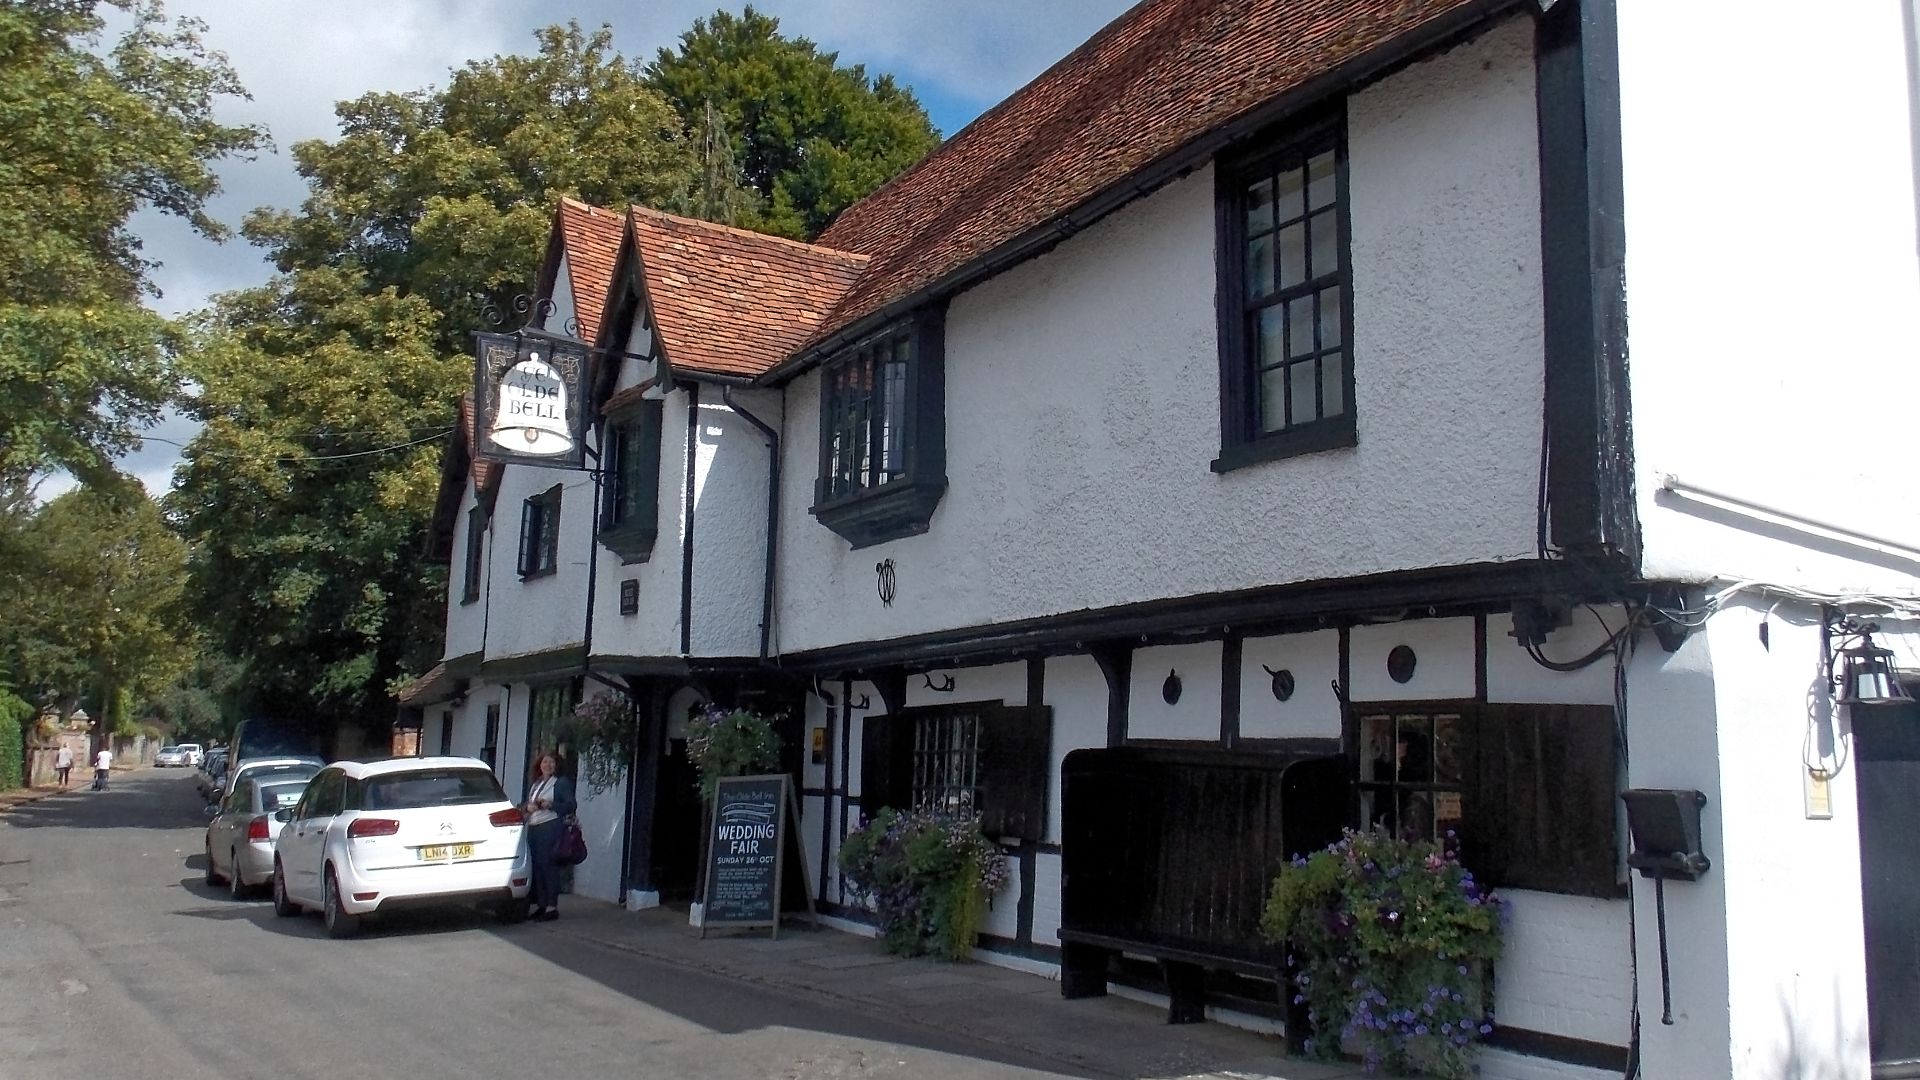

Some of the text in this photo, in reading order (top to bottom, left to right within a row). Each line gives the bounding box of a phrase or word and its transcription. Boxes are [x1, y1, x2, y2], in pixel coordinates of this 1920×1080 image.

[509, 399, 560, 420] BELL
[718, 823, 775, 840] WEDDING
[425, 846, 448, 858] LN14
[730, 840, 759, 855] FAIR
[717, 856, 745, 865] SUNDAY
[759, 854, 775, 863] OCT
